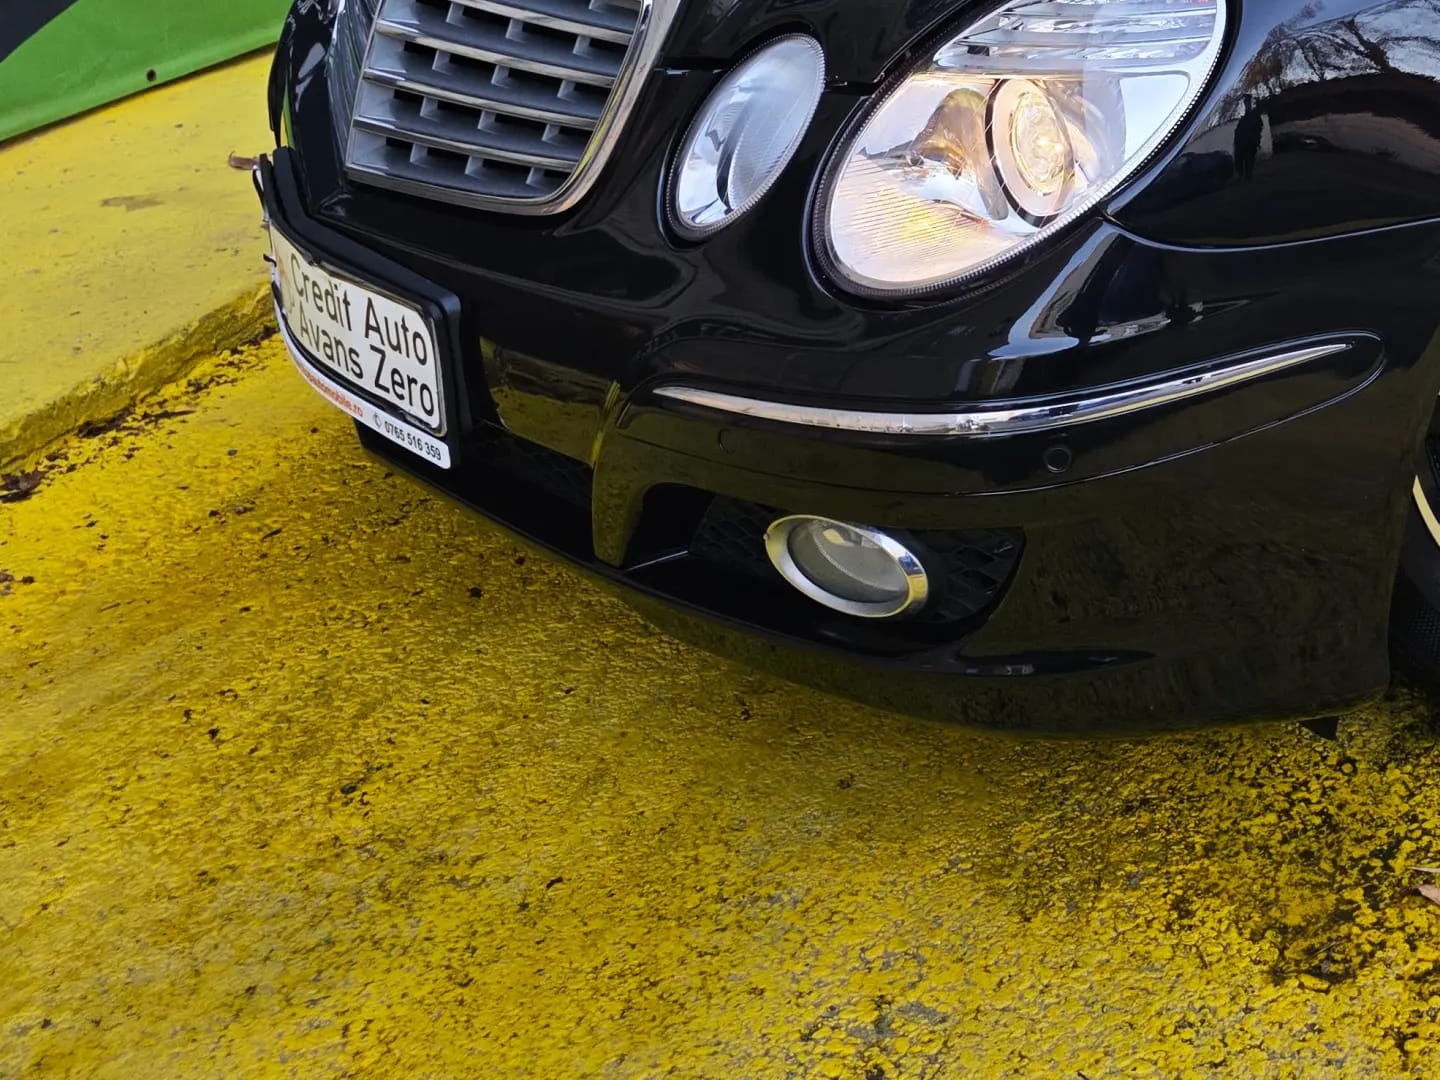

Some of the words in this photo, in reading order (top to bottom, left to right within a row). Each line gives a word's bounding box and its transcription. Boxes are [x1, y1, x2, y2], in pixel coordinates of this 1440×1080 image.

[291, 253, 352, 331] Credit
[364, 297, 427, 366] Auto
[300, 302, 364, 379] Avans
[370, 344, 435, 417] Zero
[385, 421, 405, 442] 0765
